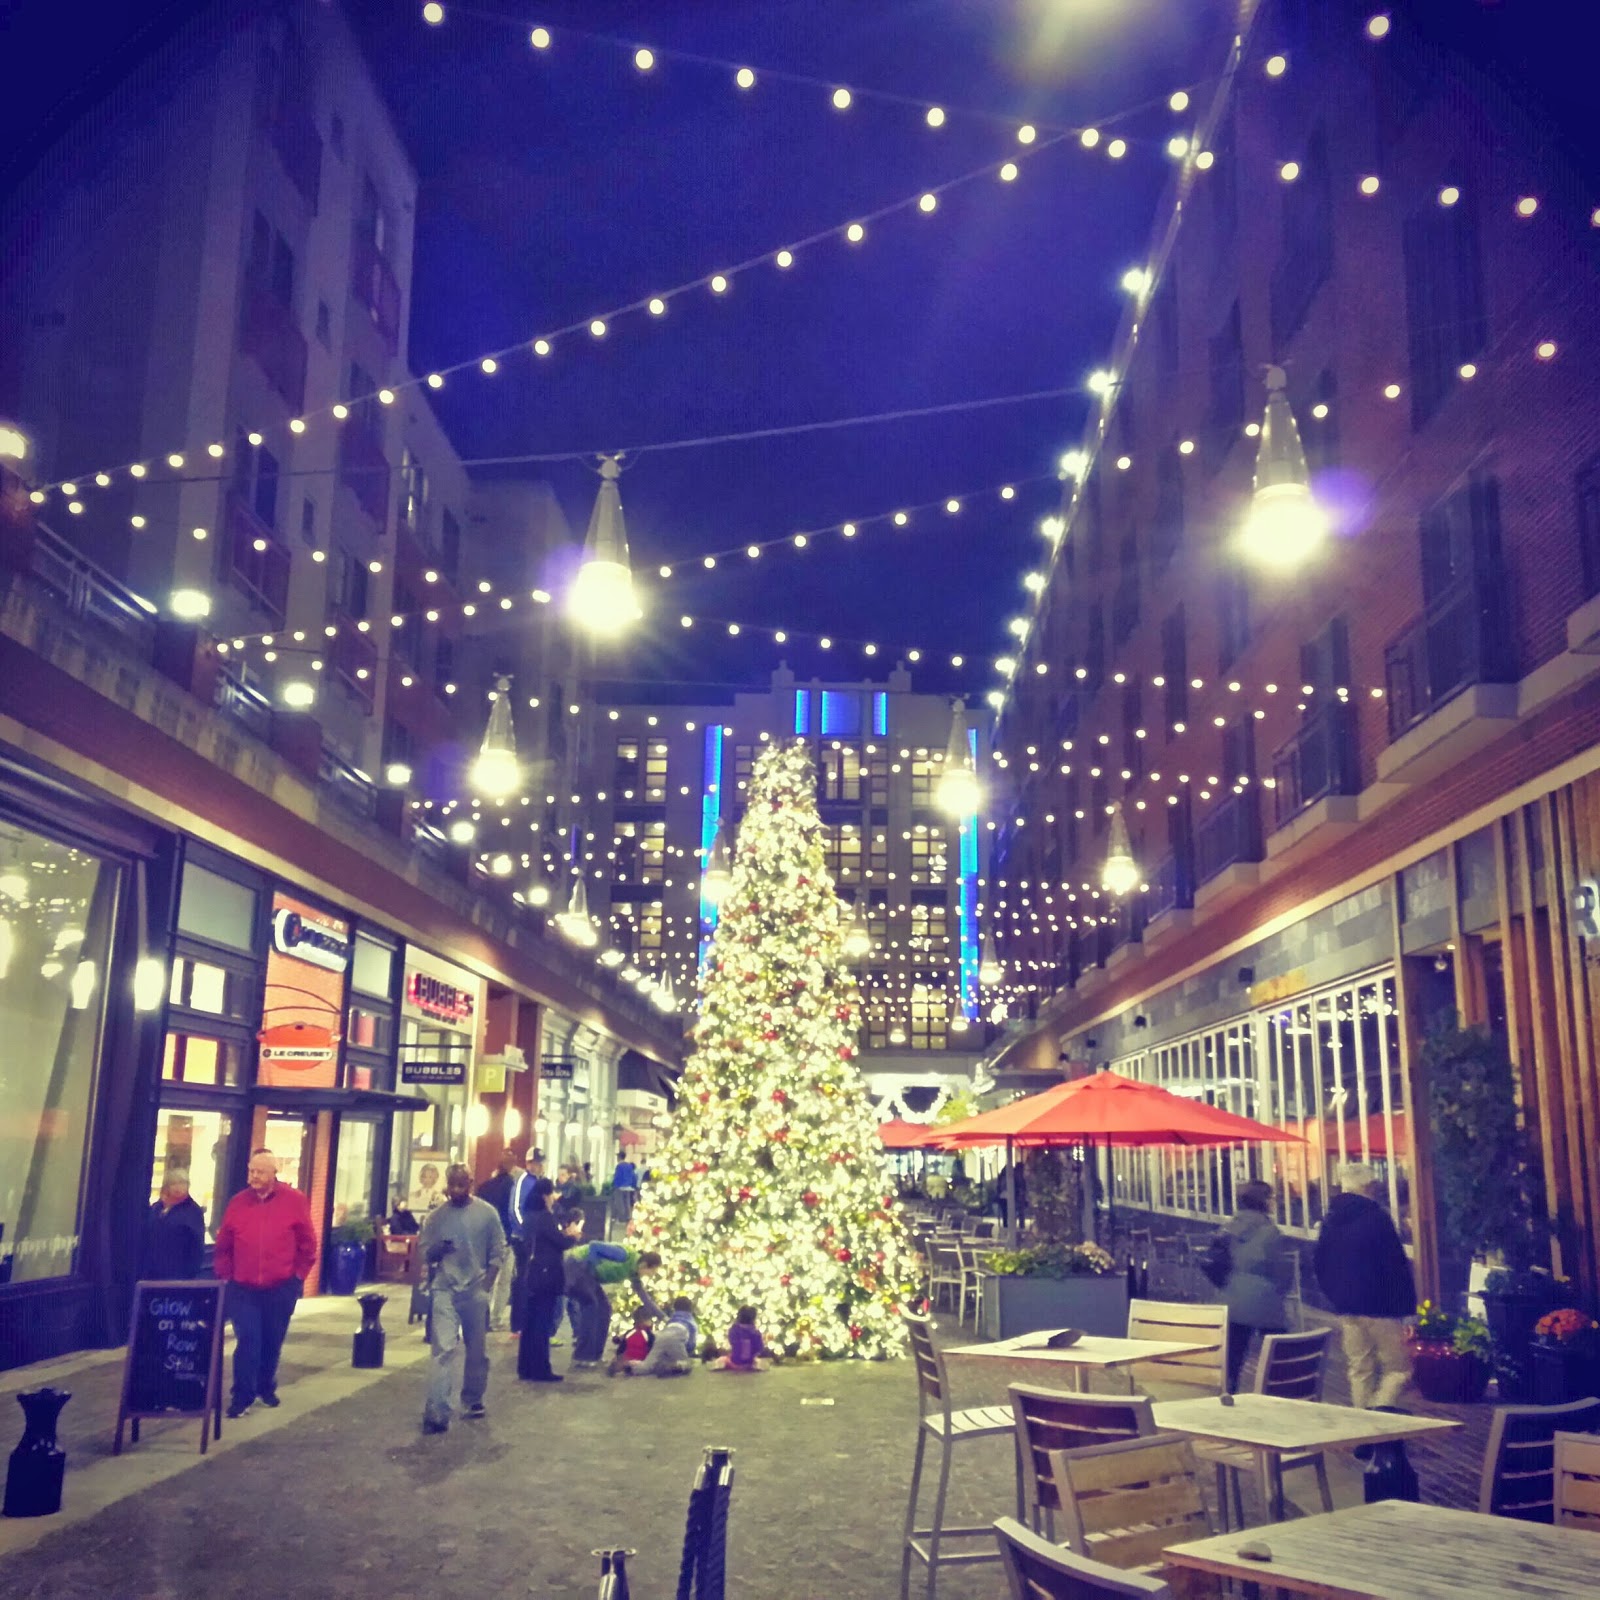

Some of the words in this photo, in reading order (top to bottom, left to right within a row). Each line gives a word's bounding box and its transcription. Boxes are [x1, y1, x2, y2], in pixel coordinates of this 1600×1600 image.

[287, 1050, 331, 1058] CREUSET
[404, 1066, 462, 1076] BUBBLES
[484, 1067, 498, 1086] P
[149, 1297, 193, 1316] Glow
[158, 1319, 174, 1331] on
[167, 1333, 199, 1352] Row
